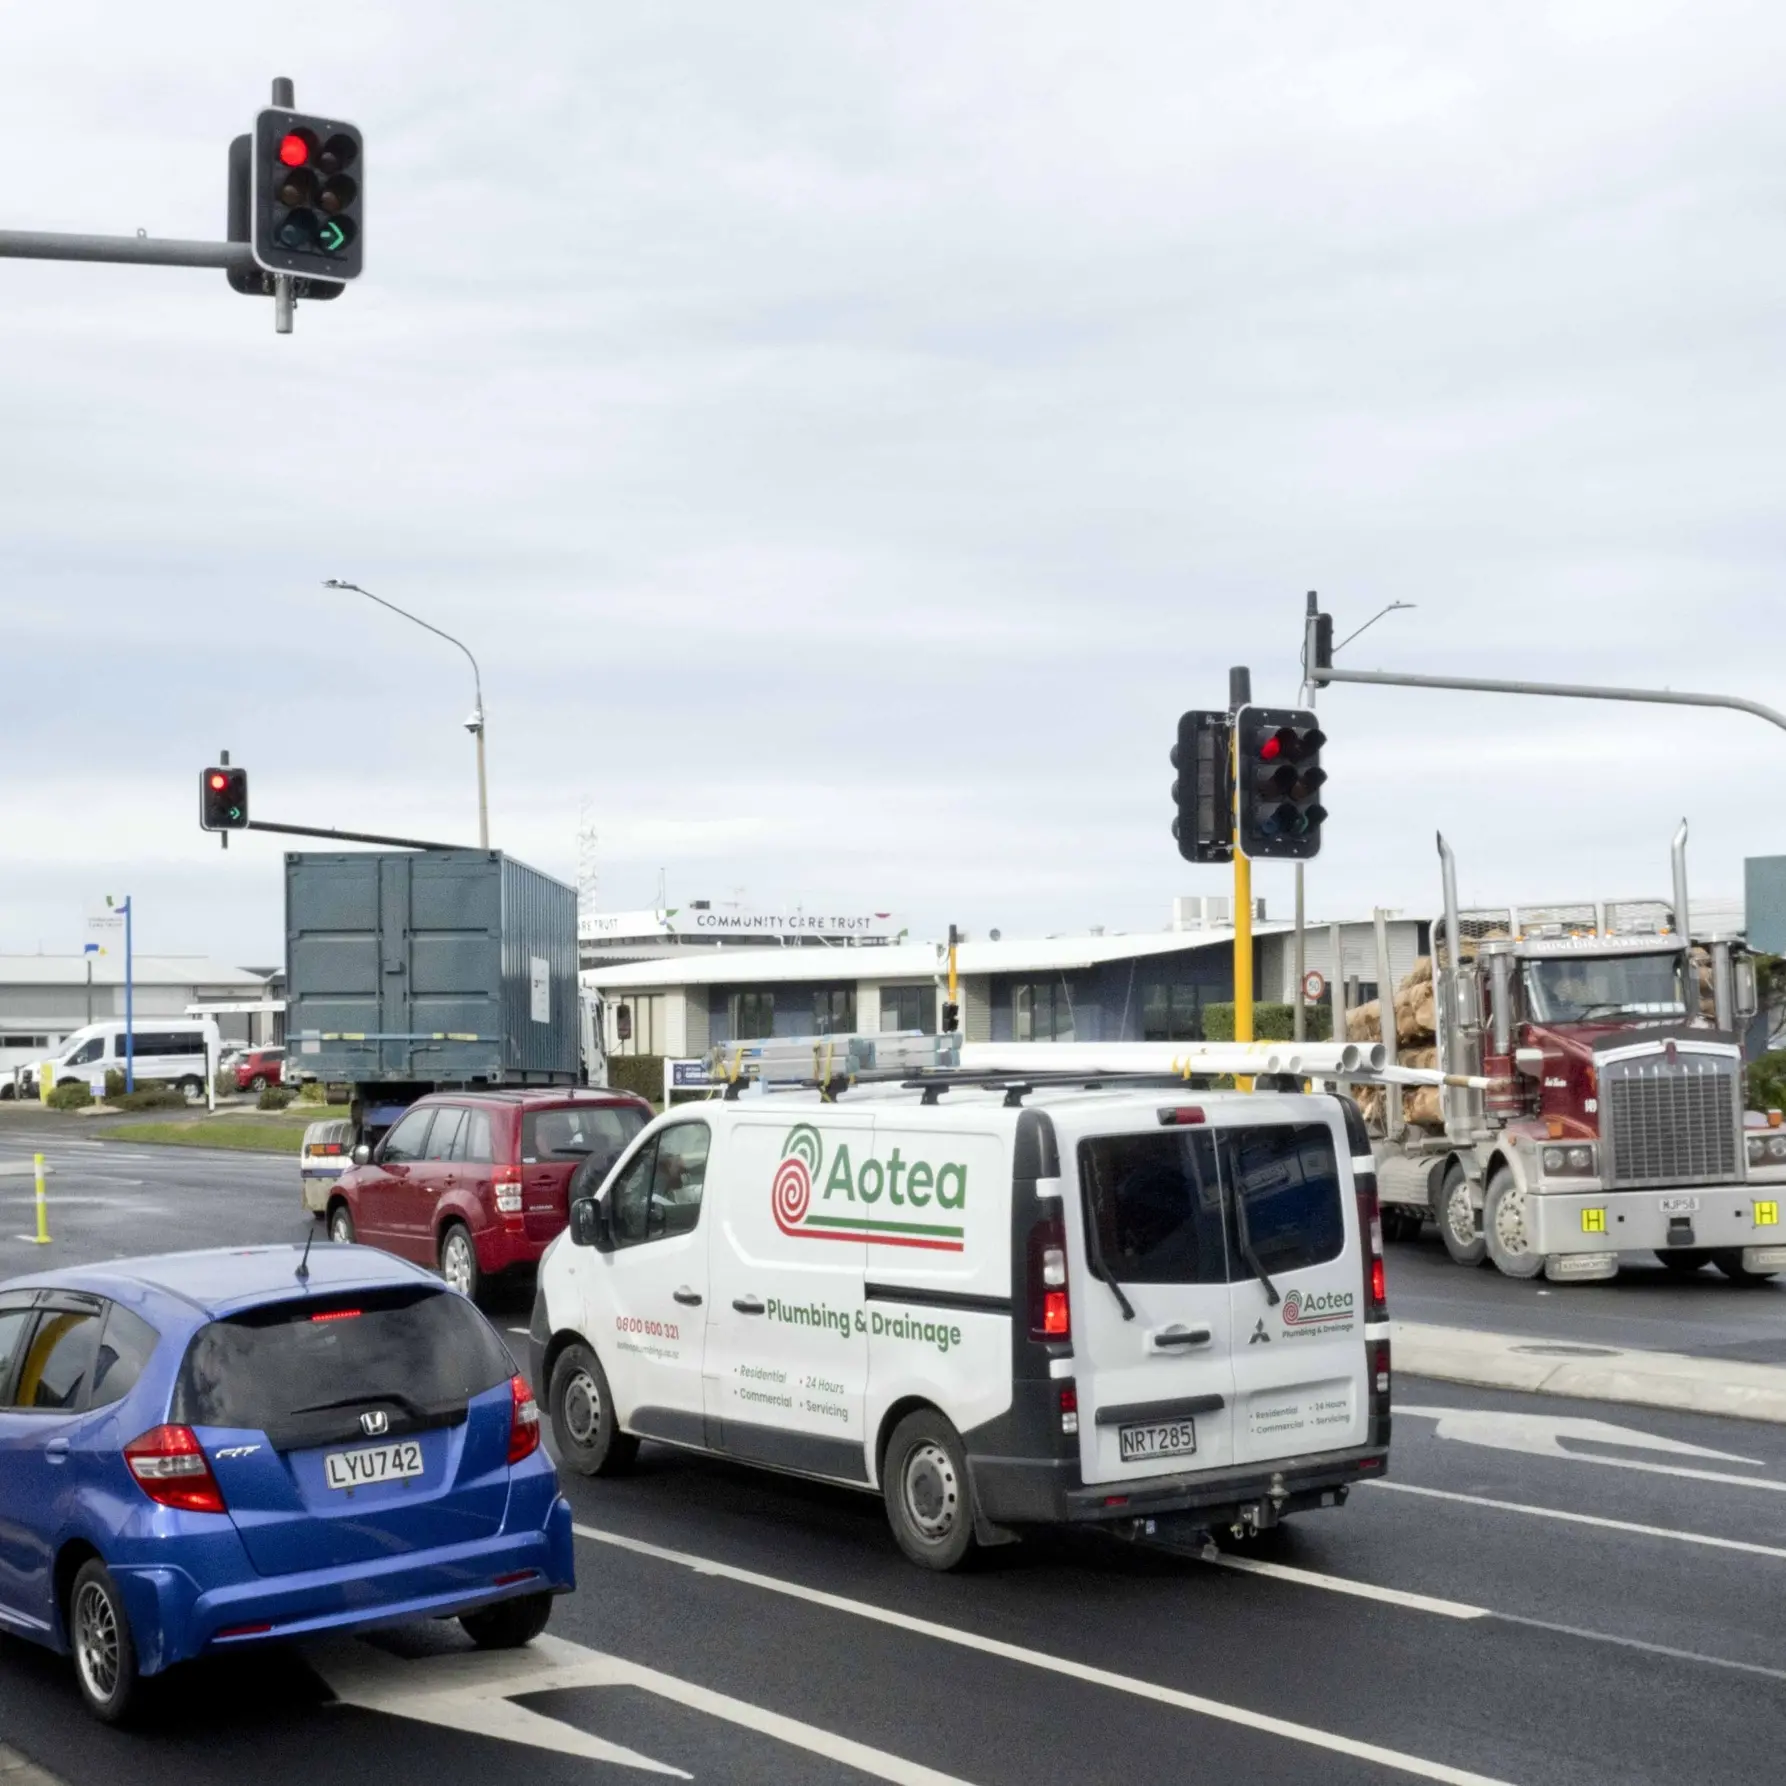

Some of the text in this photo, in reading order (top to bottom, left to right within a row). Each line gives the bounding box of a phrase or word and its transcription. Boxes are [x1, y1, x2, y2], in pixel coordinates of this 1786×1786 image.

[594, 918, 618, 931] TRUST
[697, 915, 871, 929] COMMUNITY CARE TRUST
[823, 1143, 968, 1209] Aotea
[1586, 1210, 1601, 1230] H
[1758, 1203, 1773, 1223] H
[1304, 1292, 1353, 1312] Aotea
[616, 1316, 680, 1340] 0800 600 321
[767, 1299, 961, 1352] Plumbing & Drainage
[1282, 1327, 1316, 1338] Plumbing
[1323, 1323, 1353, 1333] Drainage
[740, 1365, 845, 1394] Residential 24 Hours
[740, 1388, 849, 1422] Commercial Servicing
[1255, 1405, 1298, 1420] Residential
[1325, 1400, 1347, 1410] Hours
[1256, 1414, 1350, 1434] Commercial Servicing
[1123, 1424, 1192, 1454] NRT285
[330, 1446, 420, 1484] LYU742
